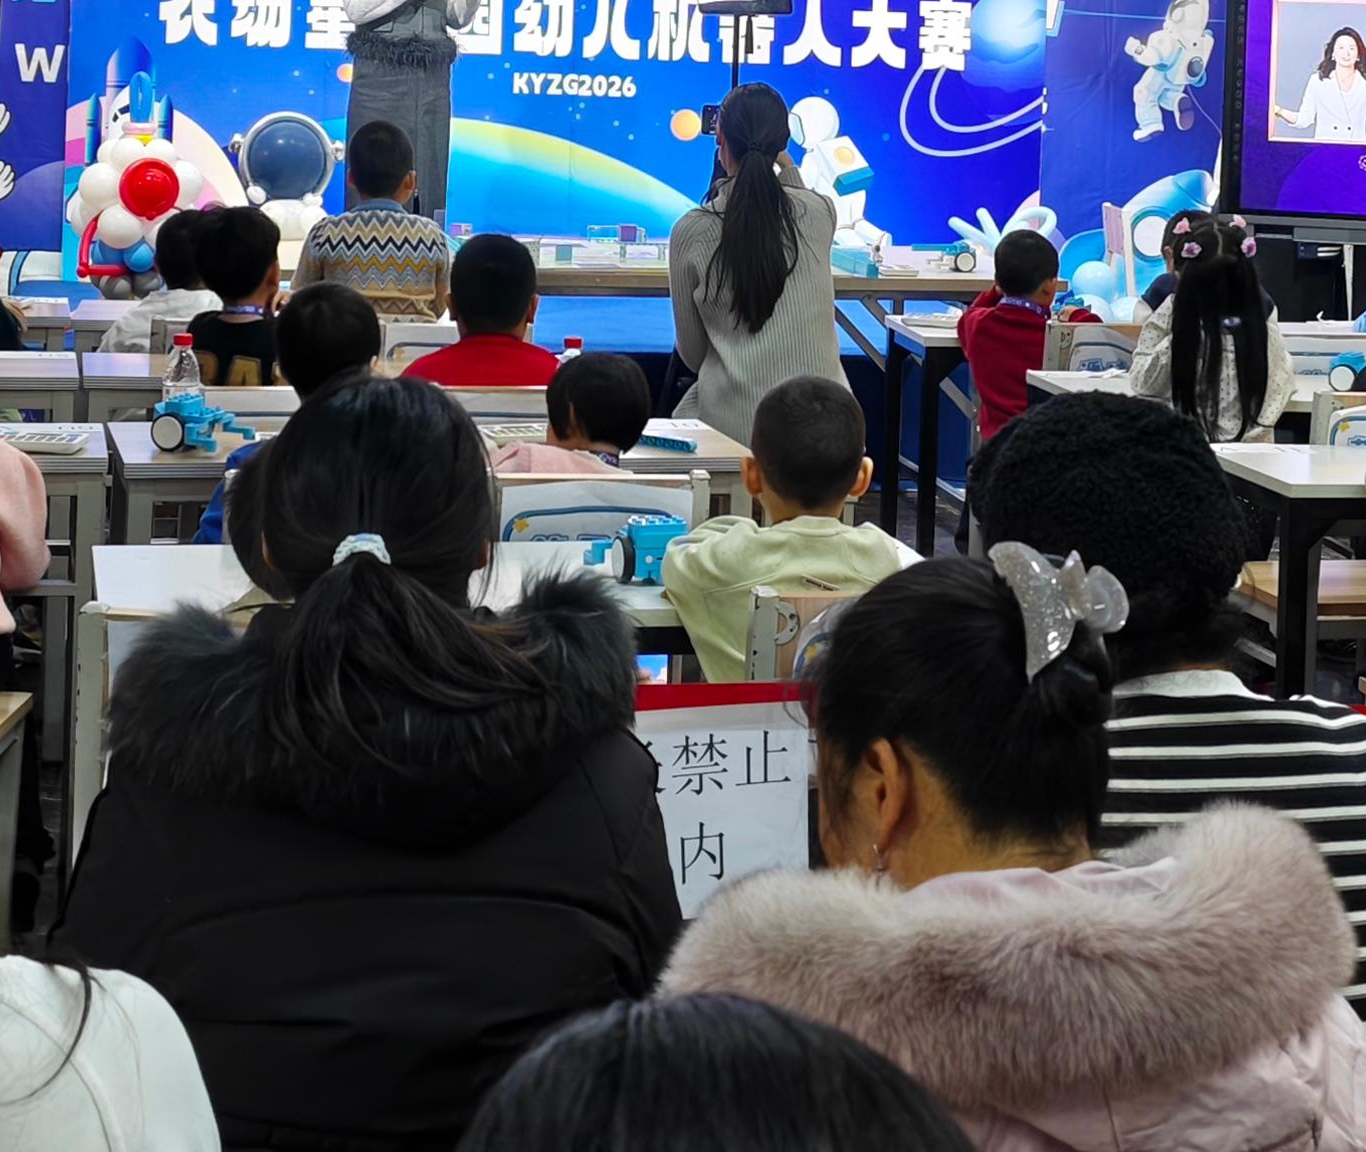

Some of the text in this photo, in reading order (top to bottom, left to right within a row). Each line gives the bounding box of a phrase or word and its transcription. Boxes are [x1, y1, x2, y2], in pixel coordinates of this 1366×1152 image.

[512, 71, 637, 98] KYZG2026
[641, 729, 792, 796] 禁止
[679, 821, 726, 885] 内
